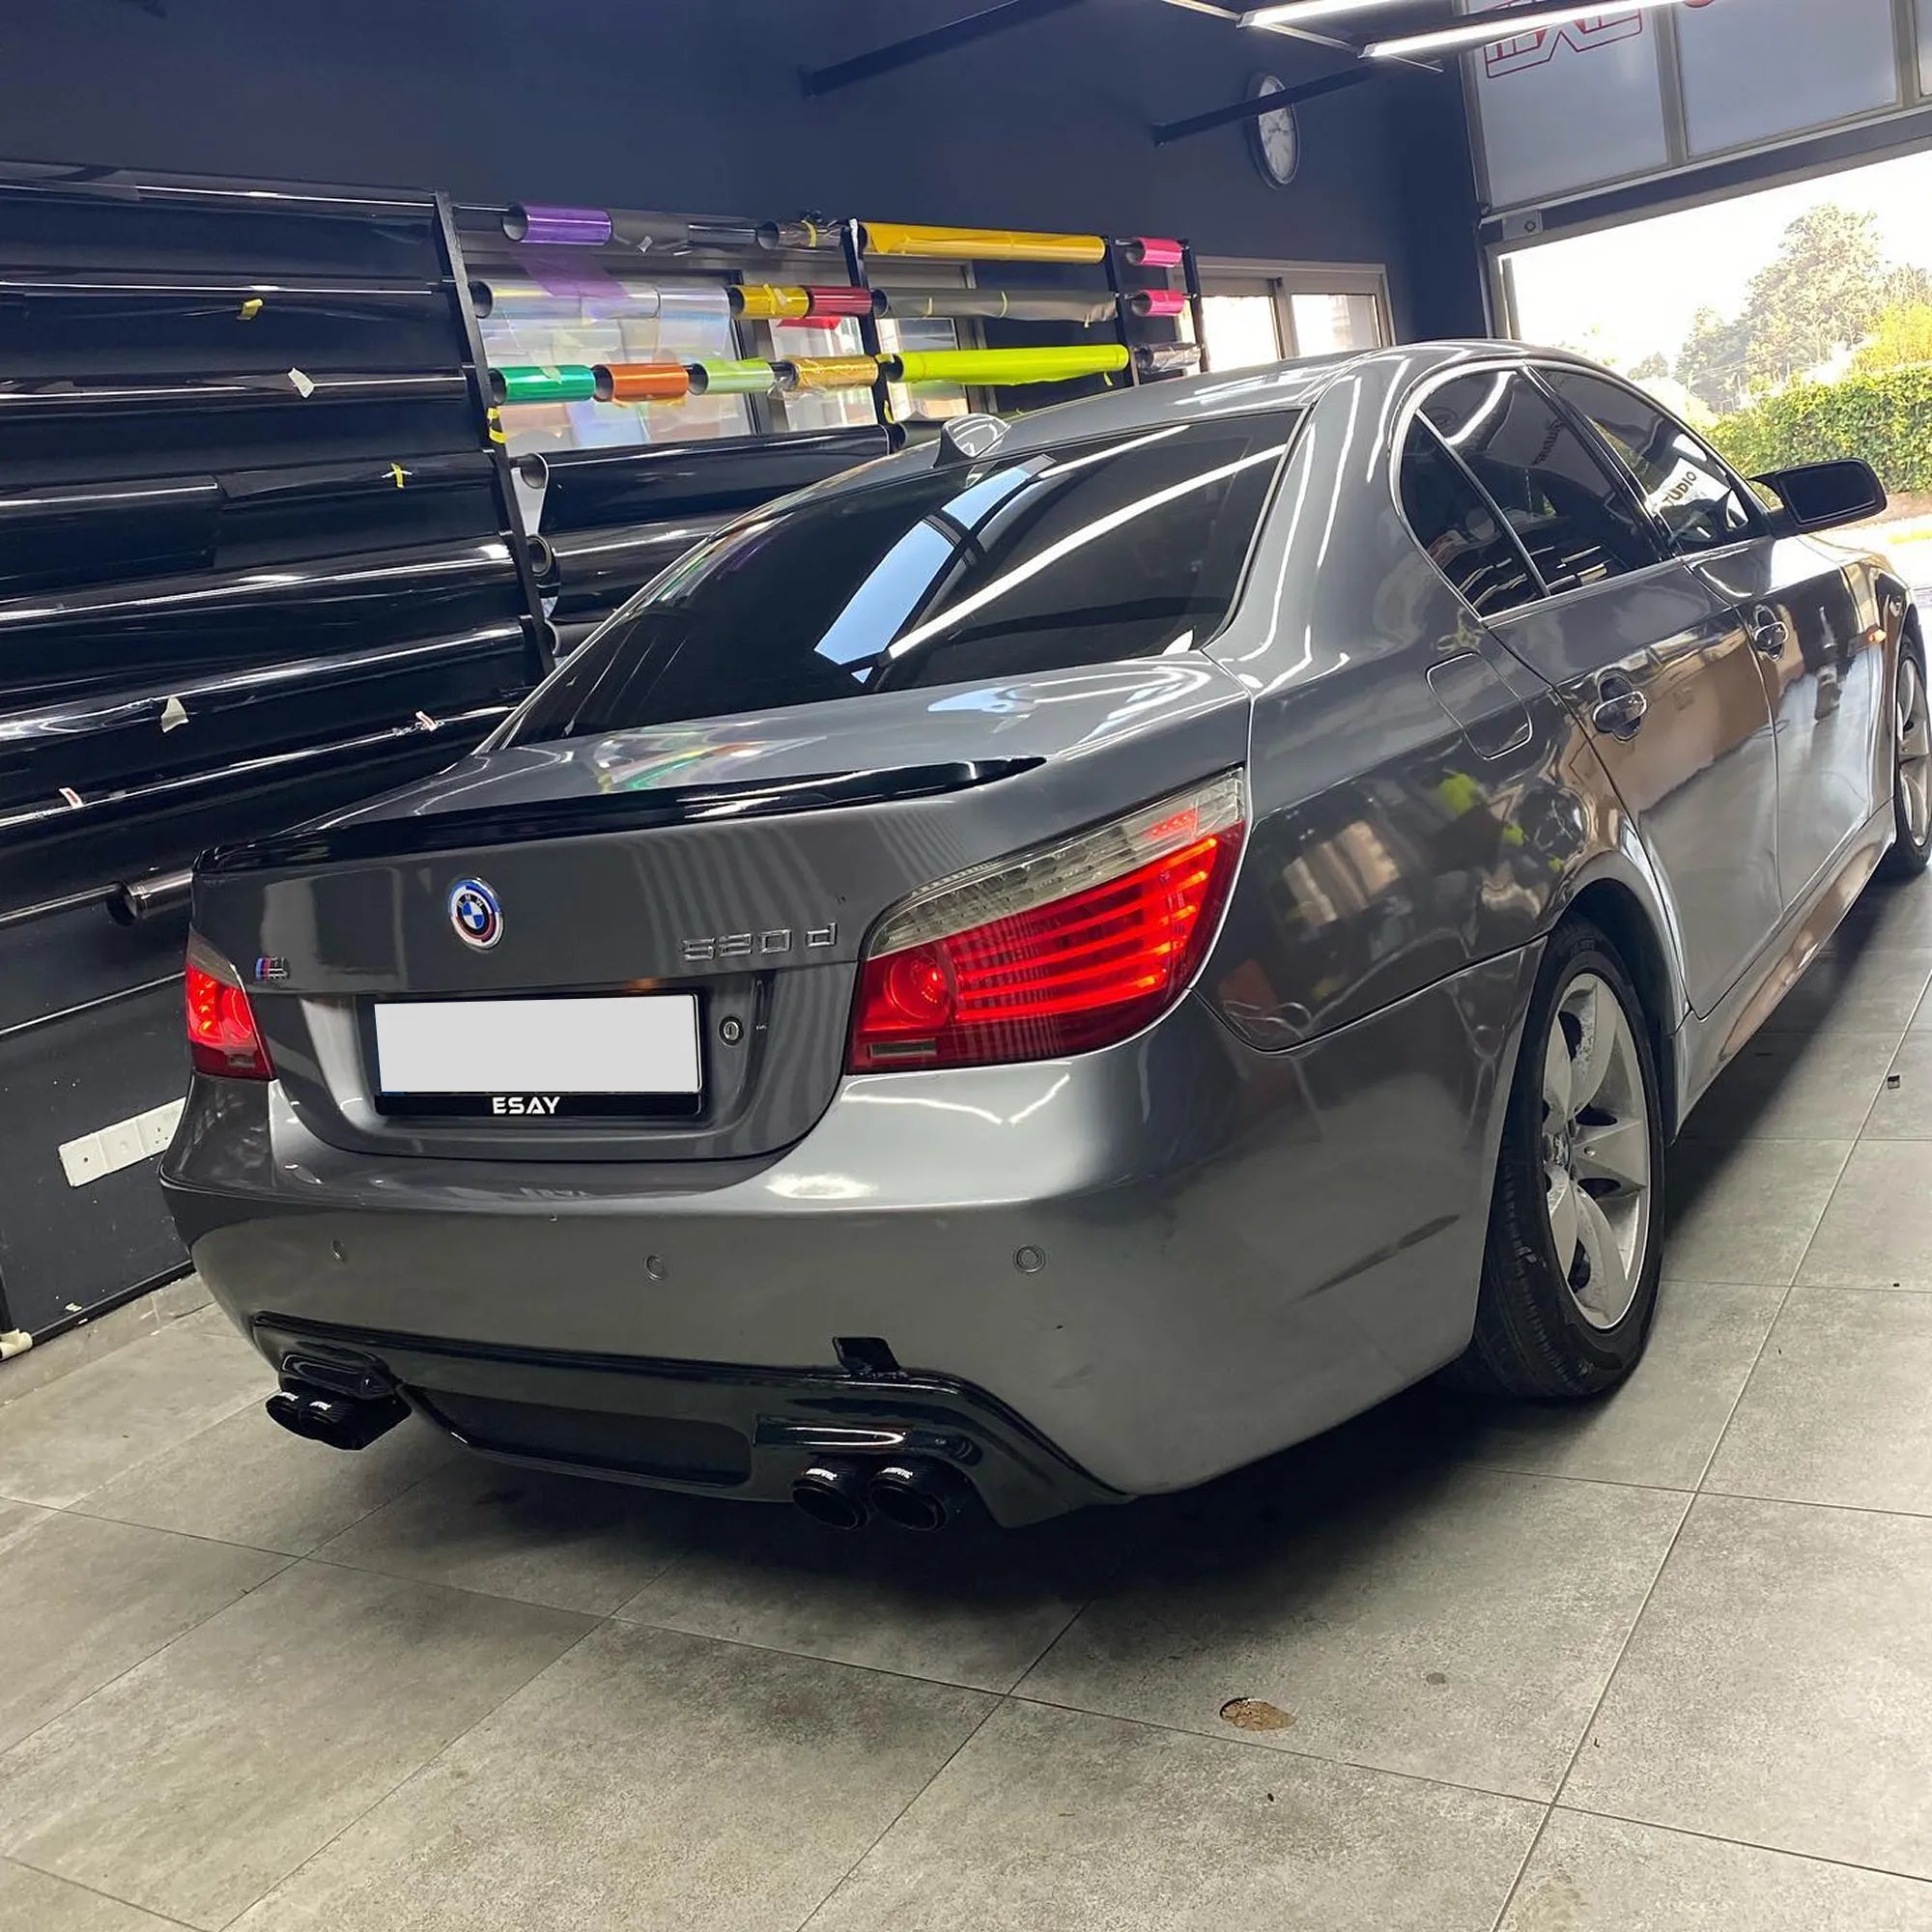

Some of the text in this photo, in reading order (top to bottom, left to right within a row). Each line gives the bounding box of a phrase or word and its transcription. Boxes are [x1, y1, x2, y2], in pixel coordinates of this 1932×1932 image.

[1661, 470, 1697, 506] TUDIO
[682, 922, 838, 962] 520 d
[492, 1096, 560, 1114] ESAY
